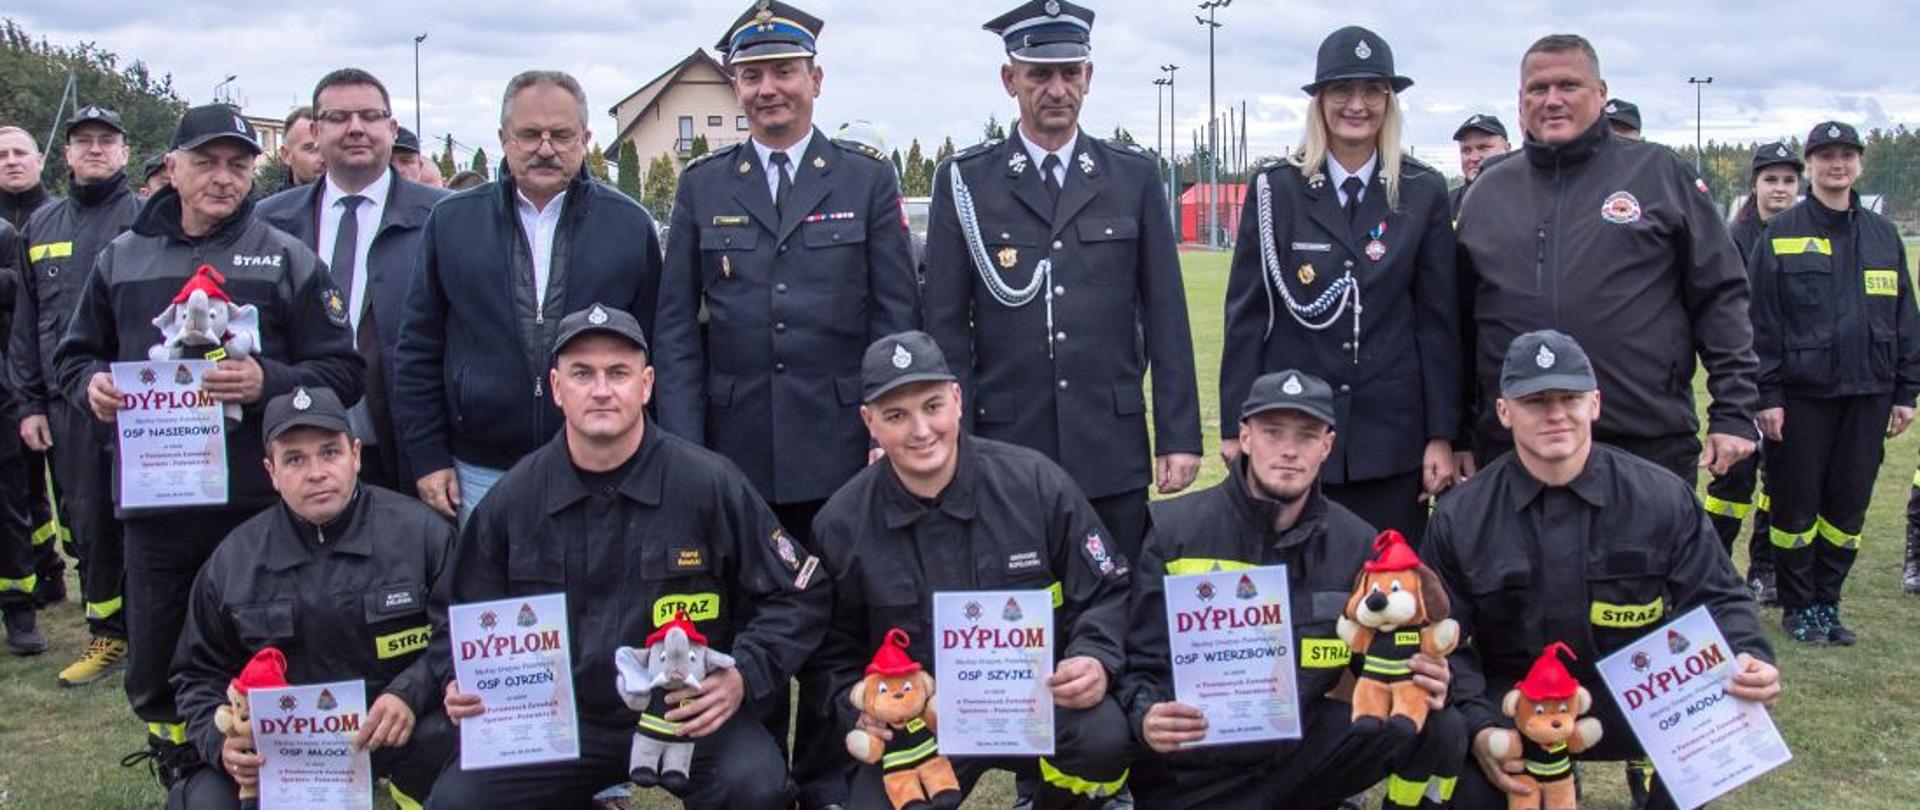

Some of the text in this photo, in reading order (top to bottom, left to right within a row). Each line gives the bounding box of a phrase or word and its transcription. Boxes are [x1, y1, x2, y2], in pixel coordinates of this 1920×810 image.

[123, 388, 216, 411] DYPLOM
[123, 425, 221, 439] OSP NASIEROWO
[1176, 603, 1283, 633] DYPLOM
[461, 630, 561, 661] DYPLOM
[943, 625, 1045, 649] DYPLOM
[1174, 646, 1288, 666] OSP WIERZBOWO
[477, 668, 554, 690] OSP OJRZEŃ
[957, 669, 1033, 681] OSP SZYJKI
[1623, 643, 1726, 711] DYPLOM
[260, 713, 360, 735] DYPLOM
[1658, 711, 1681, 731] OSP
[279, 748, 304, 757] OSP
